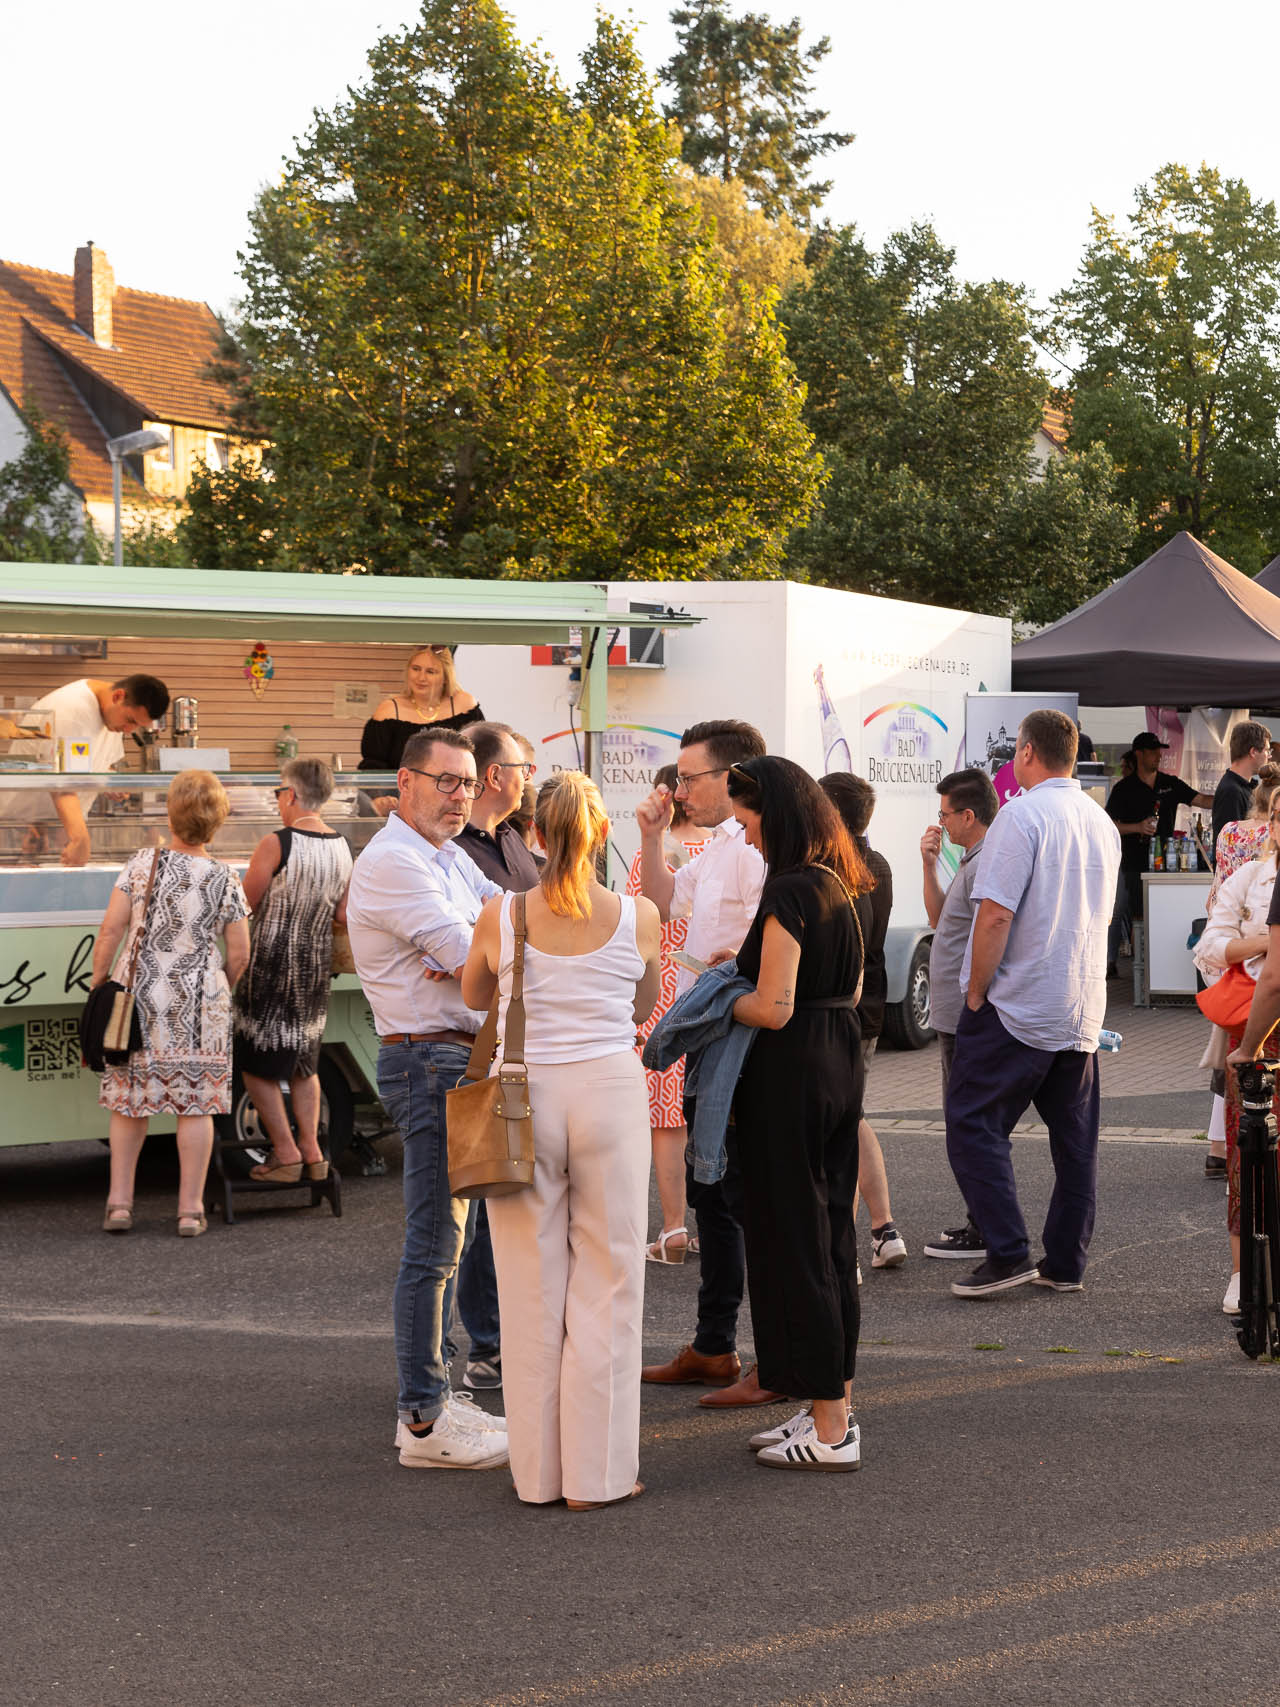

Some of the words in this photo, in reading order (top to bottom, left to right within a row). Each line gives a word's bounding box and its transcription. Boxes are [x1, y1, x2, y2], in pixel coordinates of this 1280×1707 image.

[898, 739, 916, 757] BAD
[602, 751, 634, 765] BAD
[868, 757, 942, 784] BRÜCKENAUER
[27, 1072, 55, 1082] Scan
